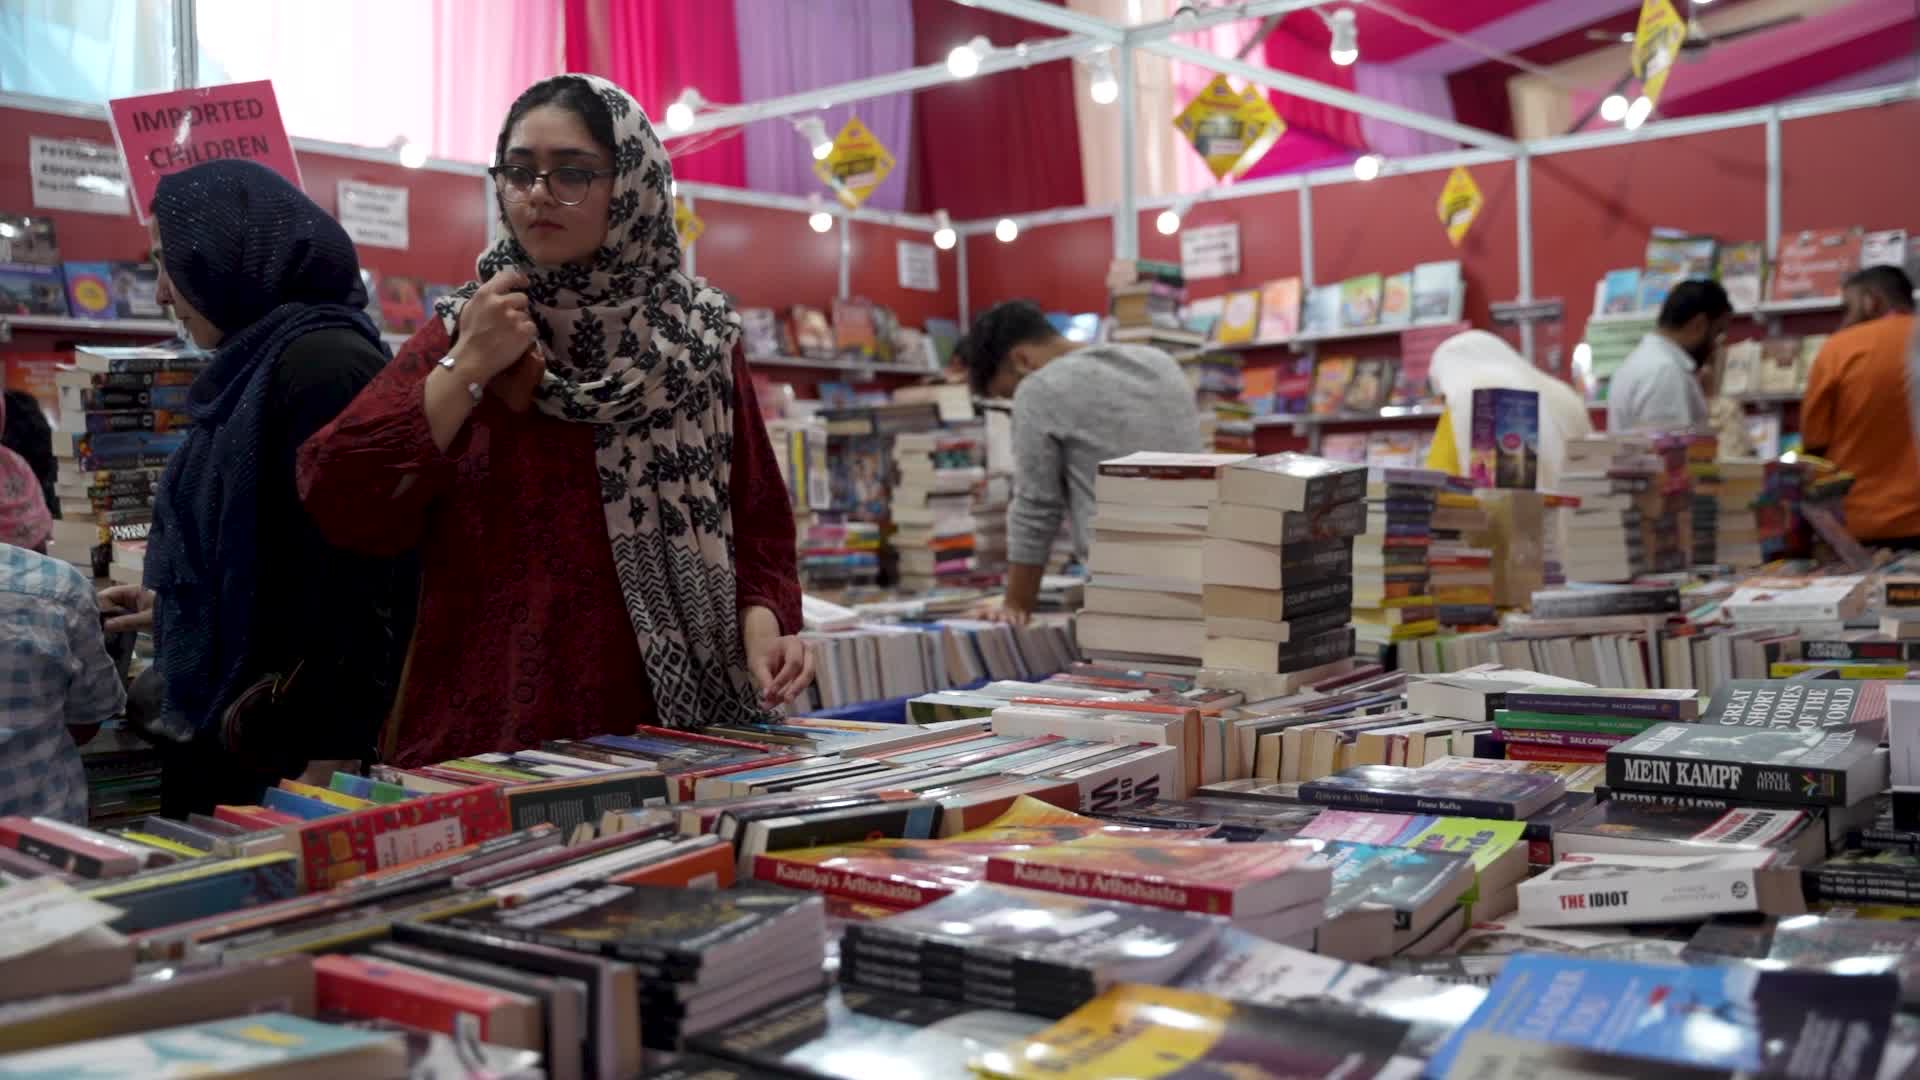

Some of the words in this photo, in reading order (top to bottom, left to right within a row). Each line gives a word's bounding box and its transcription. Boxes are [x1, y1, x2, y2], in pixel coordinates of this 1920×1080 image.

[132, 97, 264, 134] IMPORTED
[148, 135, 271, 169] CHILDREN
[1719, 689, 1753, 726] GREAT
[1744, 689, 1777, 727] SHORT
[1623, 758, 1672, 785] MEIN
[1676, 761, 1743, 790] KAMPF
[776, 860, 838, 888] Kautilya's
[1559, 893, 1586, 911] THE
[1589, 890, 1629, 909] IDIOT
